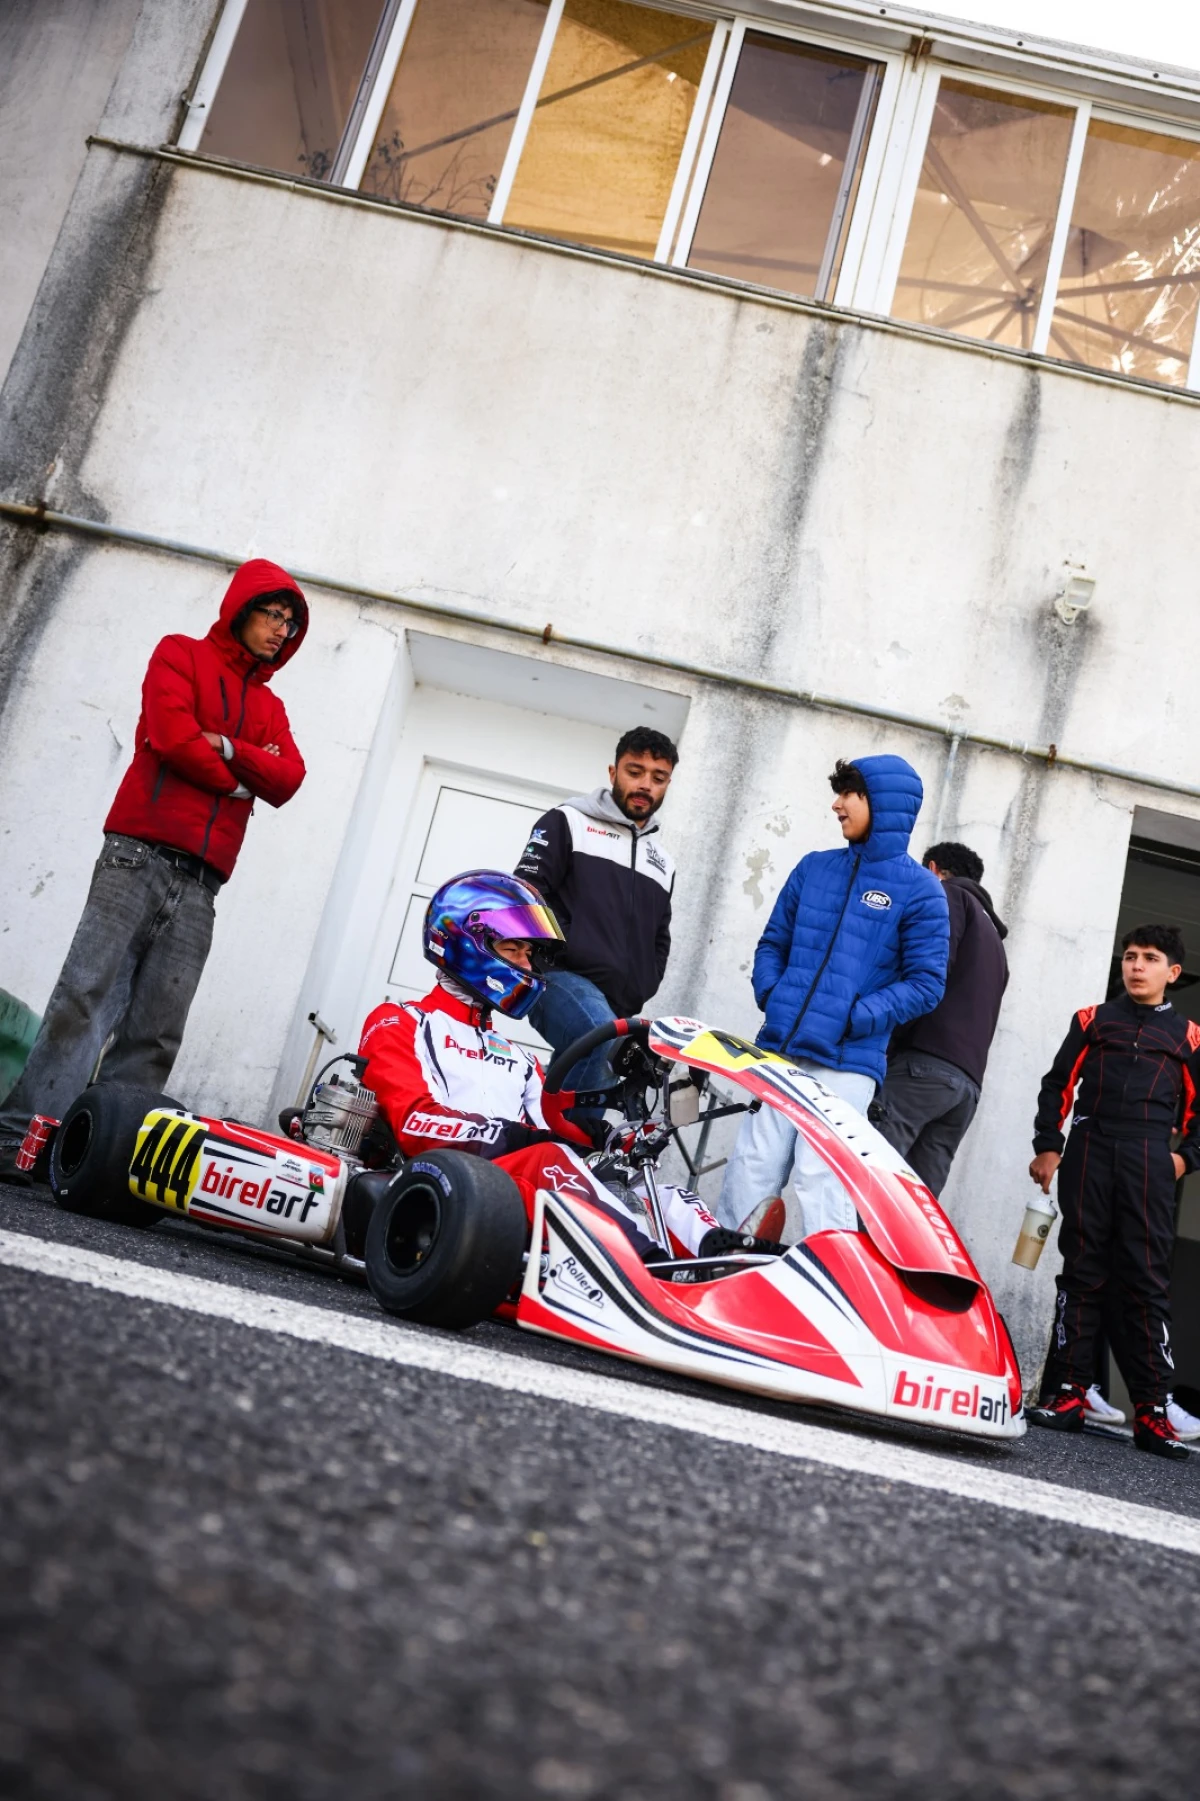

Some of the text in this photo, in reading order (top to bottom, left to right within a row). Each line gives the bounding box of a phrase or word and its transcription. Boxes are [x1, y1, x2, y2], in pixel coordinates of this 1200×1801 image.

[866, 893, 889, 905] UBS
[406, 1114, 501, 1140] birelART
[130, 1117, 206, 1211] 444
[201, 1161, 320, 1223] birelart
[893, 1370, 1008, 1426] birelart
